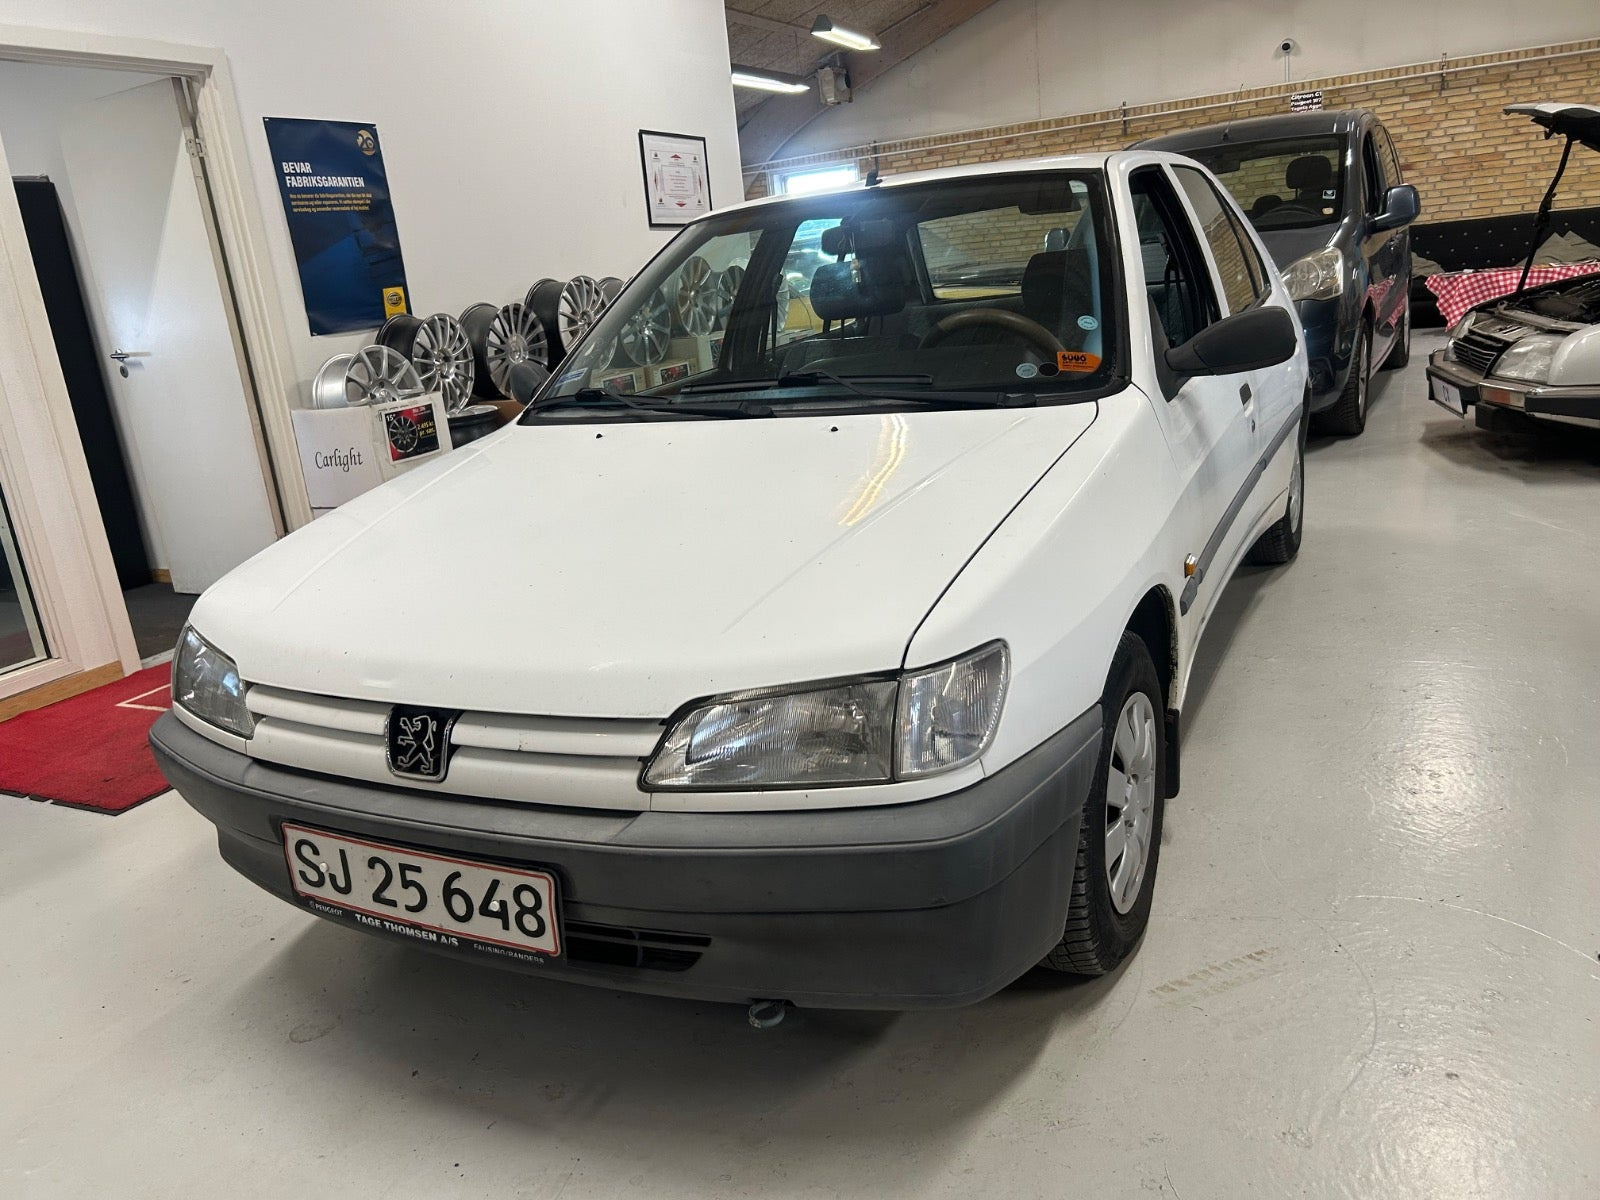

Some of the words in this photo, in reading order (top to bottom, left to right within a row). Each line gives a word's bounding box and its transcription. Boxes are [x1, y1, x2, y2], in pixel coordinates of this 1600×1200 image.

[282, 161, 312, 174] BEVAR
[285, 175, 365, 188] FABRIKSGARANTIEN
[314, 447, 363, 473] Carlight
[295, 838, 353, 895] SJ
[367, 856, 428, 913] 25
[442, 870, 547, 938] 648
[315, 903, 343, 916] PEUGEOT
[354, 913, 383, 928] TAGE
[383, 921, 437, 942] THOMSEN
[440, 935, 459, 946] A/S
